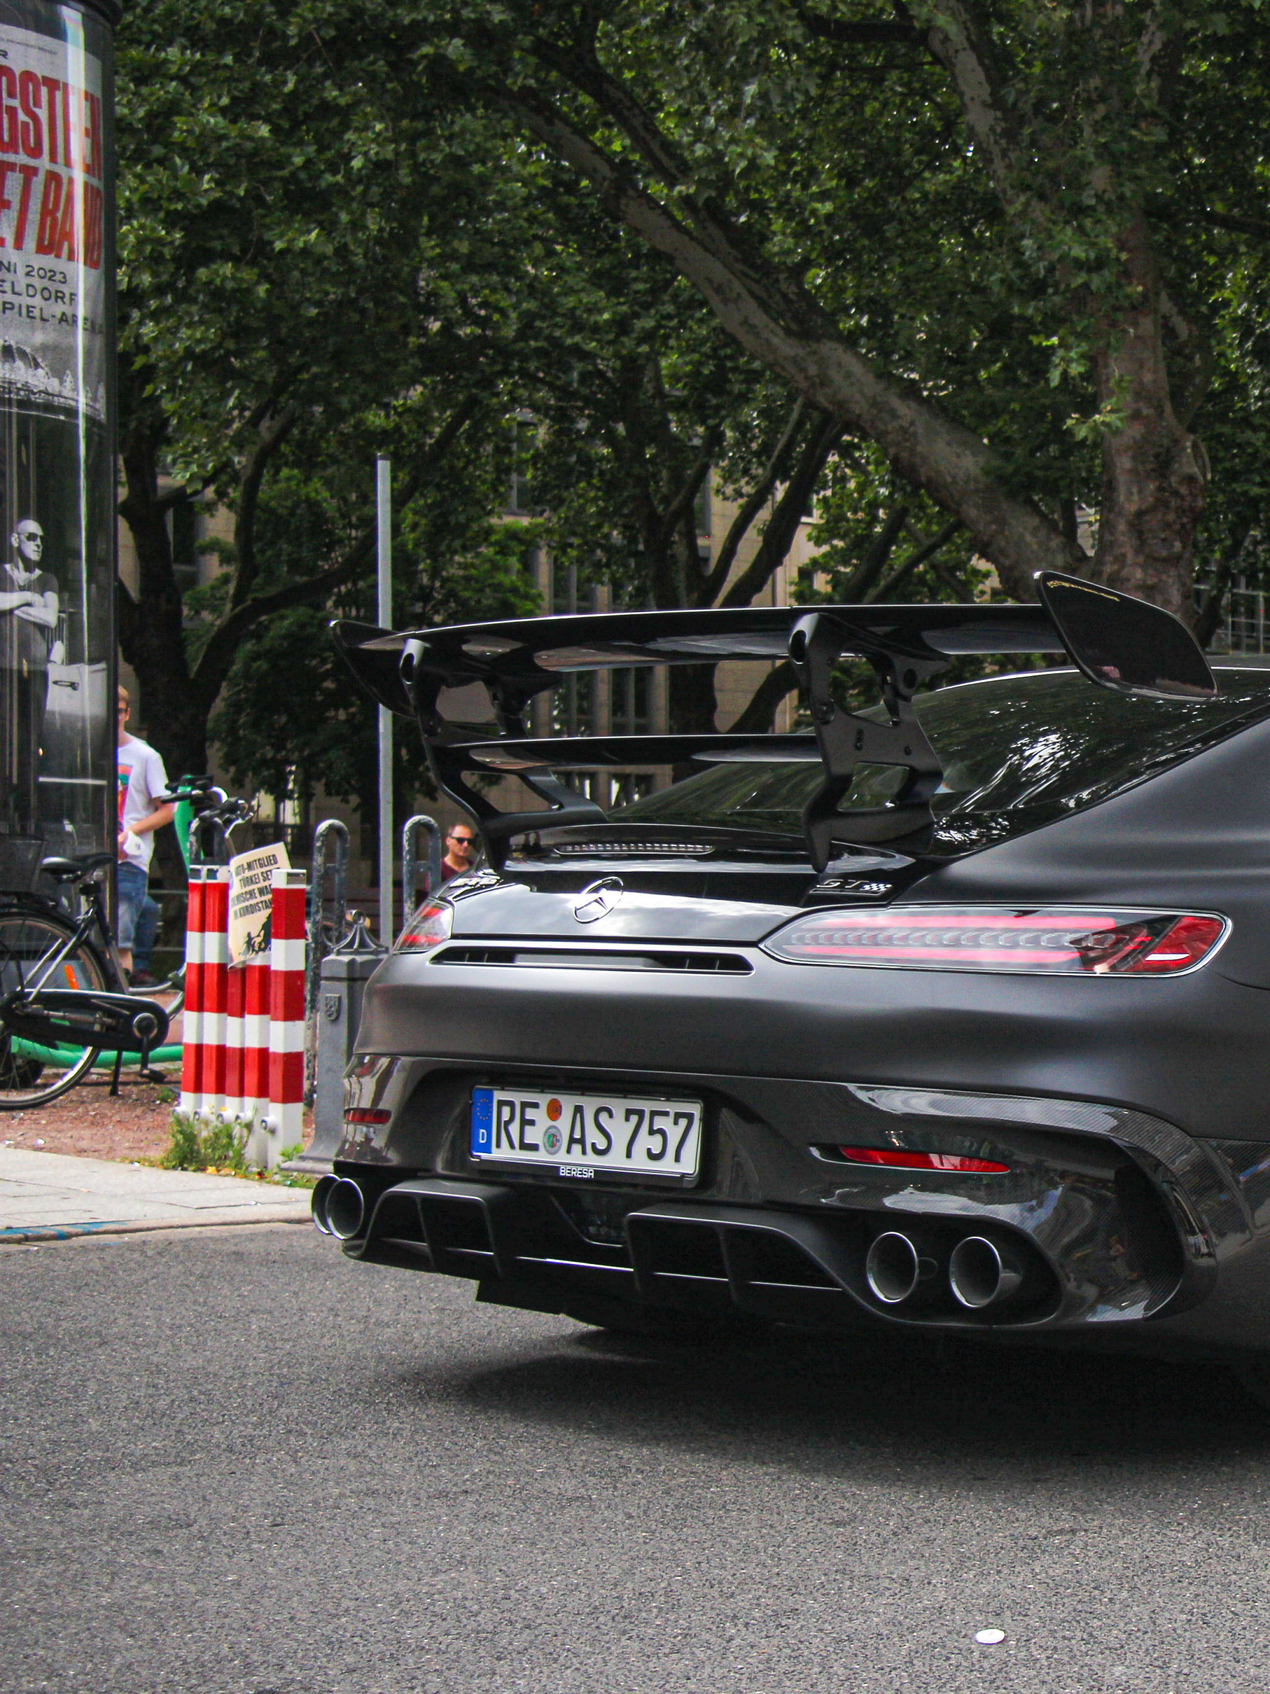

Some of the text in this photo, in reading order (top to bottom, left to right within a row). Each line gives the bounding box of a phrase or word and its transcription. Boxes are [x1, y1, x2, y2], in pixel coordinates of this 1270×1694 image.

[24, 264, 68, 284] 2023
[478, 1129, 487, 1144] D
[496, 1099, 540, 1152] RE
[624, 1107, 696, 1163] 757
[559, 1166, 595, 1179] BERESA
